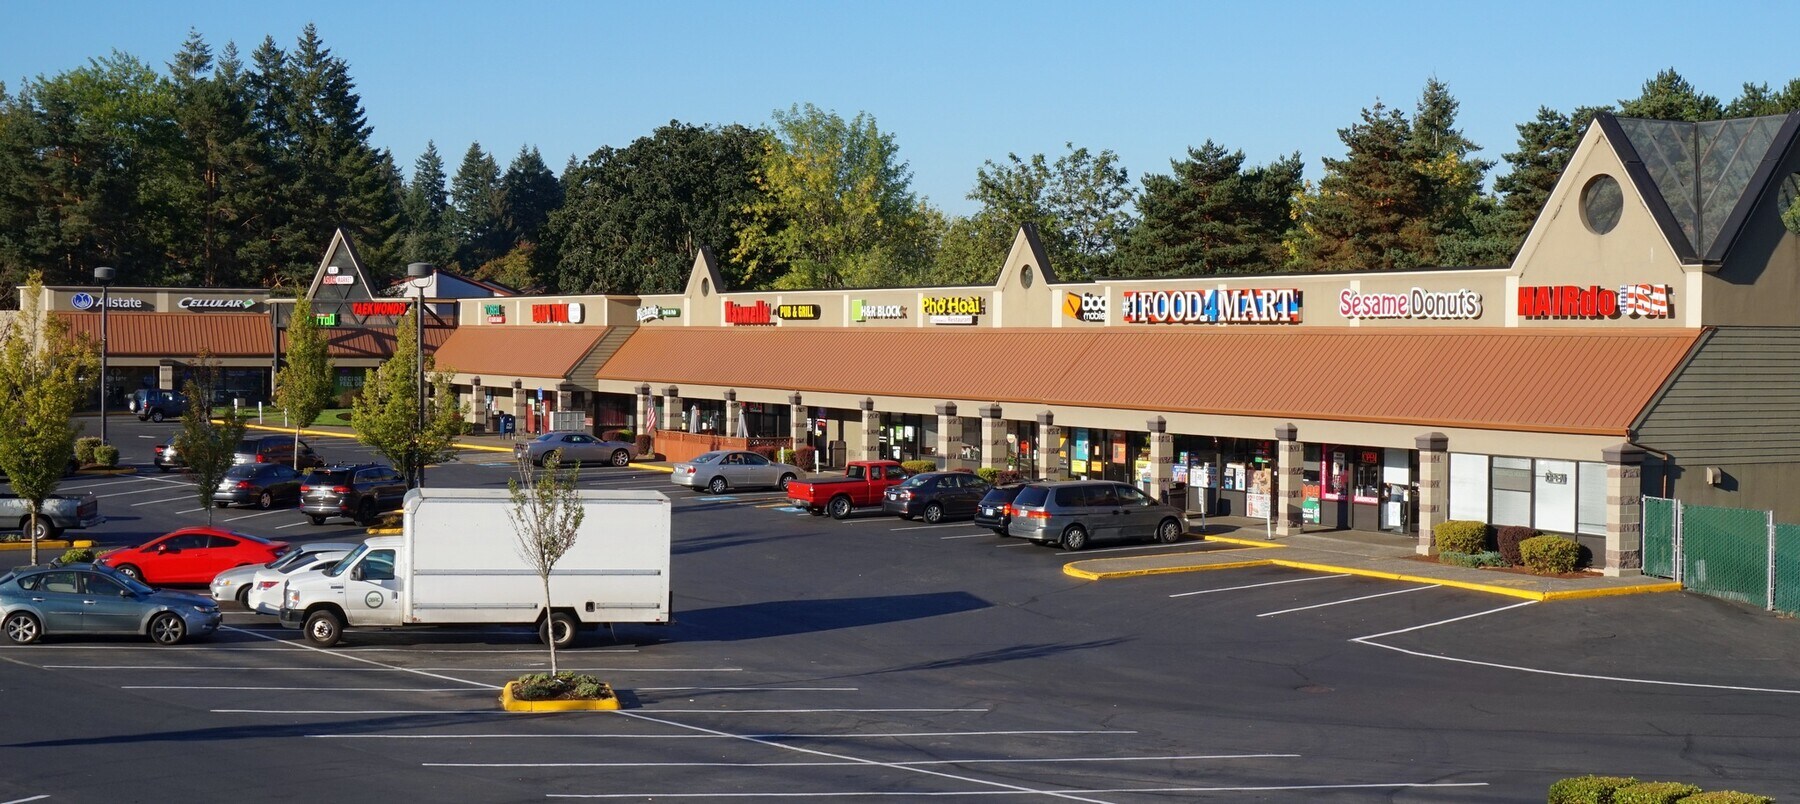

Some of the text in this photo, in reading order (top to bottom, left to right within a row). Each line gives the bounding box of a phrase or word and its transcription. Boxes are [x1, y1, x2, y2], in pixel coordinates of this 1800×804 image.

[95, 297, 142, 309] Allstate
[177, 297, 243, 309] CELLULAR
[1218, 289, 1294, 321] MART
[1340, 287, 1477, 317] Sesame Donuts
[1518, 283, 1668, 316] HAIRdo USA
[352, 303, 406, 316] TAEKWONDO
[780, 305, 814, 318] PUB & GRILL
[861, 305, 902, 317] H&R BLOCK
[1083, 312, 1105, 320] mobile
